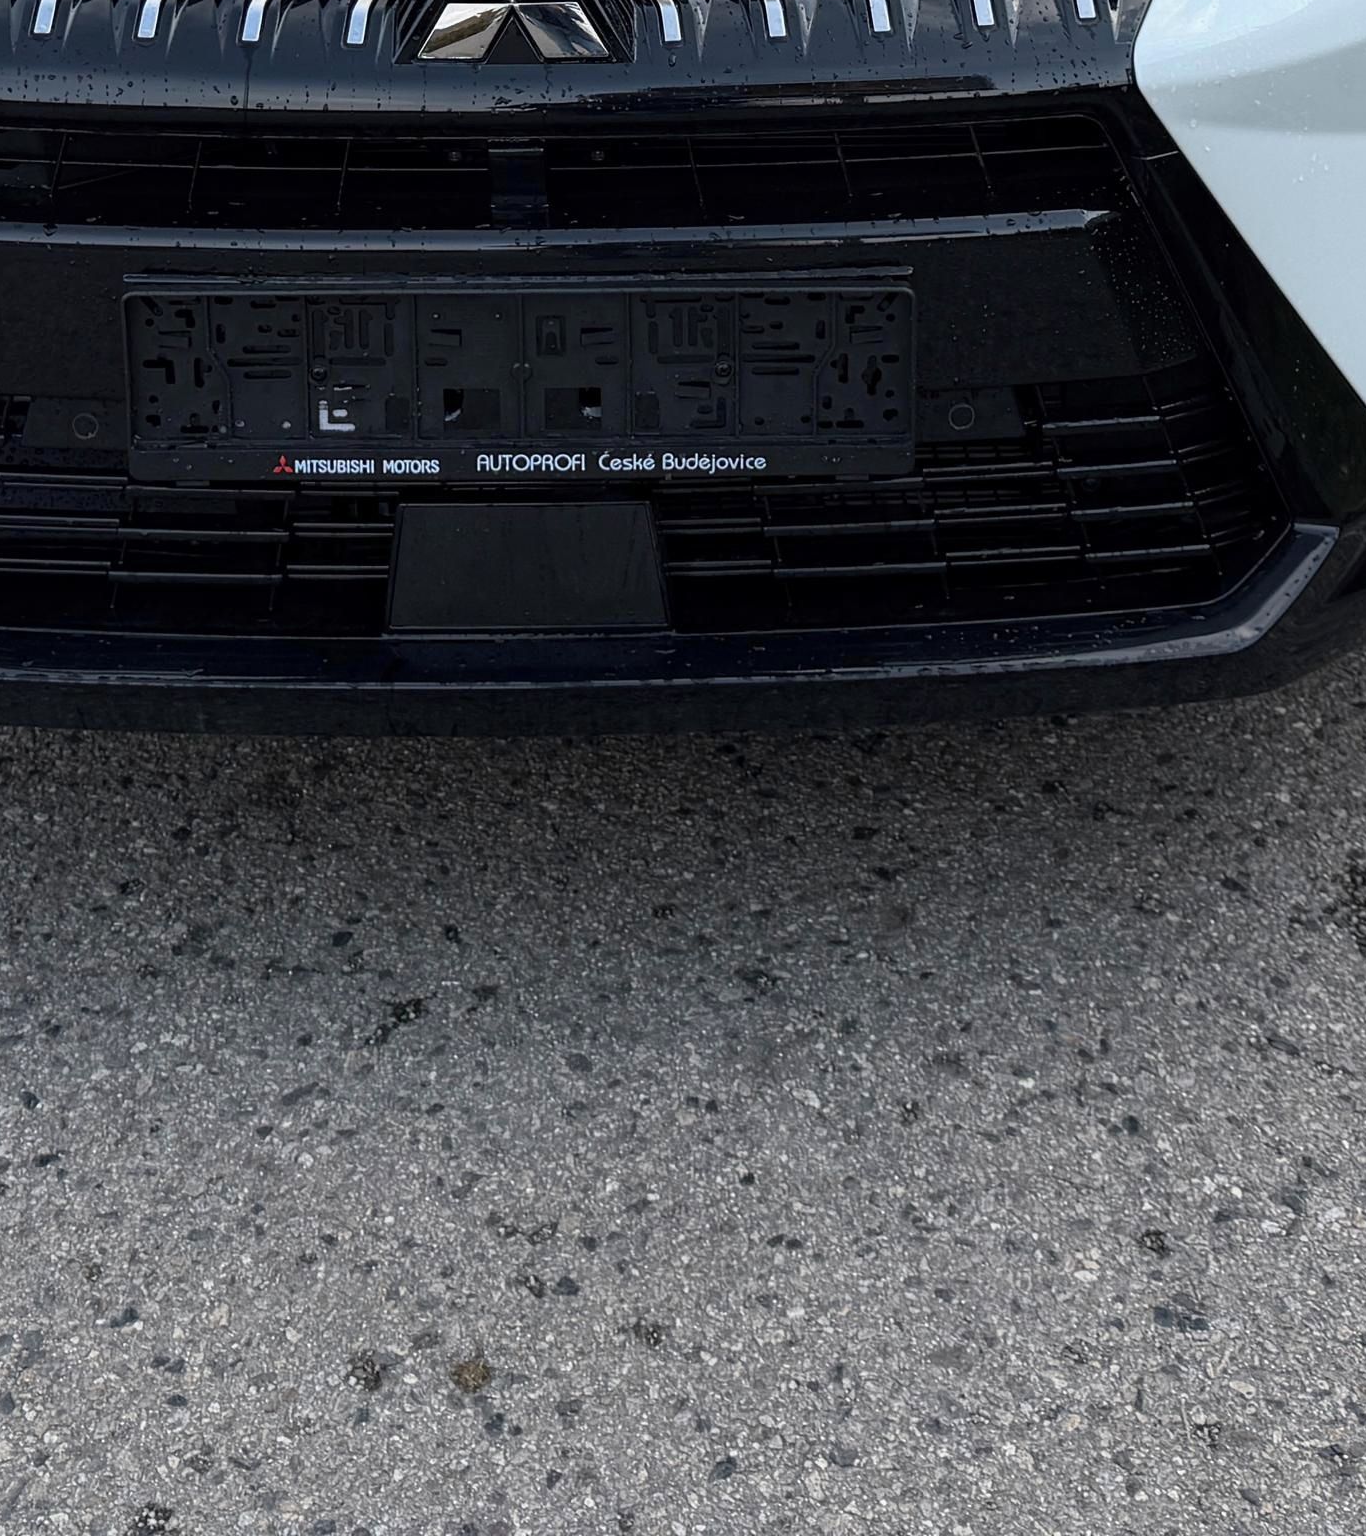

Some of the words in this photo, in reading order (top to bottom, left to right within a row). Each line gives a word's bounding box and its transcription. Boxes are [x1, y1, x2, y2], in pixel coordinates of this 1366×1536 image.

[294, 459, 375, 474] MITSUBISHI
[382, 459, 440, 474] MOTORS
[476, 454, 586, 472] AUTOPROFI
[598, 450, 656, 471] České
[661, 452, 767, 475] Budějovice
